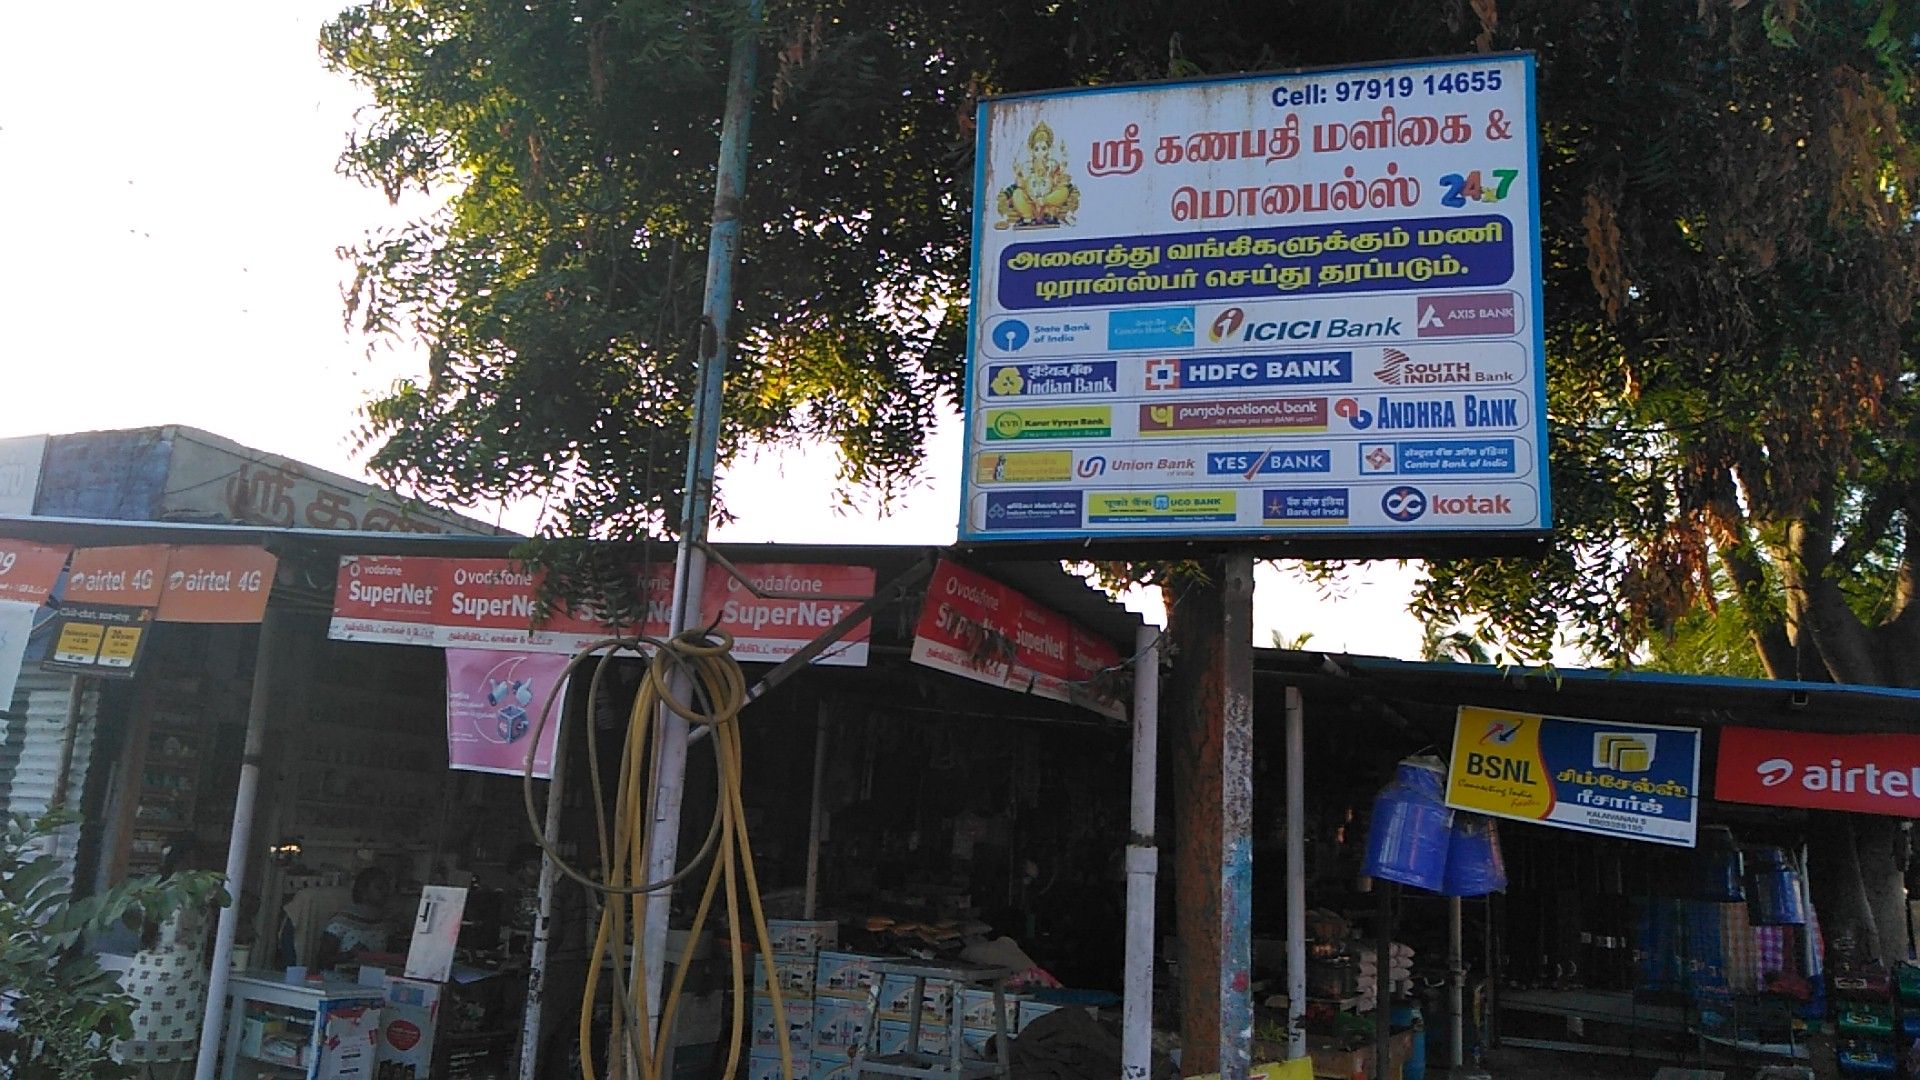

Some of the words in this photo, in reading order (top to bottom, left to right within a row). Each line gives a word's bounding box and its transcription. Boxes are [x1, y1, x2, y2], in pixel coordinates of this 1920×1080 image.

[1272, 84, 1327, 107] Cell:
[1335, 76, 1414, 102] 97919
[1424, 70, 1502, 95] 14655
[1155, 113, 1300, 167] கணபதி
[1313, 106, 1472, 153] மளிகை
[1485, 109, 1513, 142] &
[1171, 162, 1421, 222] மொபைல்ஸ்
[1008, 244, 1161, 271] அனைத்து
[1167, 226, 1410, 260] வங்கிகளுக்கும்
[1418, 222, 1504, 246] மணி
[1035, 268, 1199, 301] டிரான்ஸ்பர்
[1205, 264, 1312, 291] செய்து
[1447, 309, 1476, 320] AXIS
[1479, 307, 1514, 319] BANK
[1063, 324, 1090, 332] Bank
[1243, 320, 1321, 341] ICICI
[1327, 317, 1402, 338] Bank
[1034, 335, 1046, 343] of
[1047, 335, 1075, 343] India
[1188, 363, 1258, 382] HDFC
[1266, 360, 1341, 379] BANK
[1404, 362, 1470, 374] SOUTH
[1404, 373, 1471, 384] INDIAN
[1476, 371, 1514, 383] Bank
[1027, 378, 1072, 394] Indian
[1074, 377, 1113, 393] Bank
[1179, 404, 1224, 420] punjab
[1227, 401, 1283, 415] national
[1283, 401, 1317, 413] bank
[1377, 397, 1456, 429] ANDHRA
[1464, 394, 1518, 427] BANK
[1112, 459, 1153, 471] Union
[1157, 457, 1196, 470] Bank
[1214, 456, 1248, 469] YES
[1270, 454, 1323, 469] BANK
[1405, 460, 1440, 469] Central
[1442, 459, 1467, 468] Bank
[1469, 459, 1481, 468] of
[1482, 458, 1508, 467] India
[1170, 498, 1191, 507] UCO
[1193, 498, 1221, 506] BANK
[1287, 508, 1310, 516] Bank
[1310, 508, 1321, 516] of
[1322, 507, 1345, 516] India
[1432, 494, 1512, 515] kotak
[86, 569, 126, 591] airtel
[131, 569, 154, 591] 4G
[186, 568, 231, 592] airtel
[238, 569, 262, 592] 4G
[364, 565, 403, 577] vodafone
[349, 580, 434, 607] SuperNet
[722, 600, 844, 630] SuperNet
[1467, 752, 1537, 785] BSNL
[1802, 758, 1920, 798] airtel
